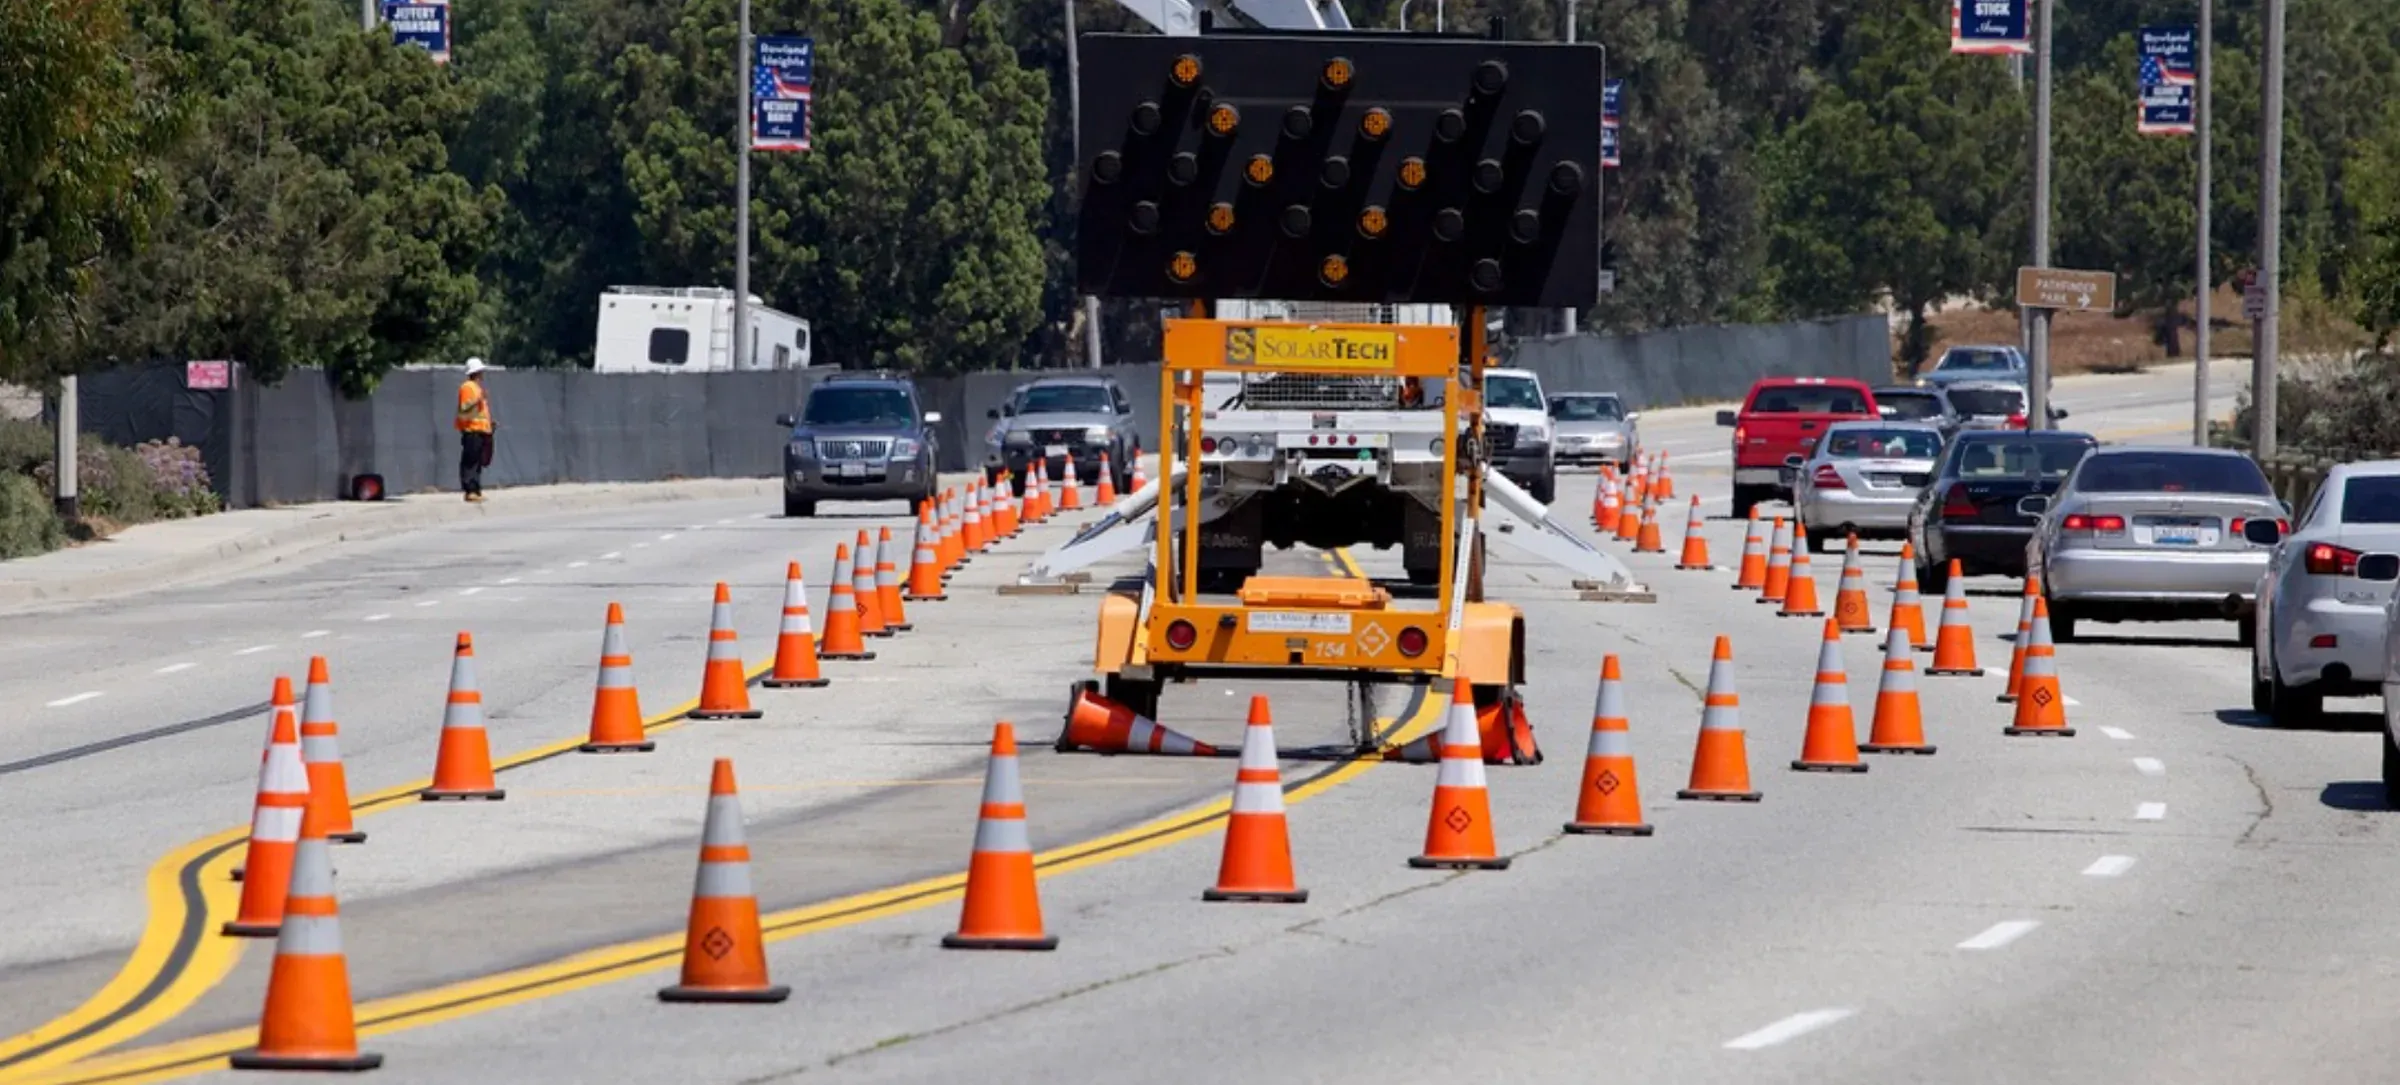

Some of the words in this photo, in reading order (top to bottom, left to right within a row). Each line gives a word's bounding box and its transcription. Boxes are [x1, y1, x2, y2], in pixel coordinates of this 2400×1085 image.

[1975, 2, 2010, 16] STICK
[1975, 20, 2008, 37] Army
[2143, 31, 2190, 42] Rowland
[761, 43, 808, 55] Rowland
[2146, 44, 2188, 55] Heights
[762, 55, 805, 67] Heights
[767, 126, 792, 138] Army
[2035, 279, 2098, 293] PATHFINDER
[2040, 292, 2068, 303] PARK
[1315, 641, 1346, 657] 154
